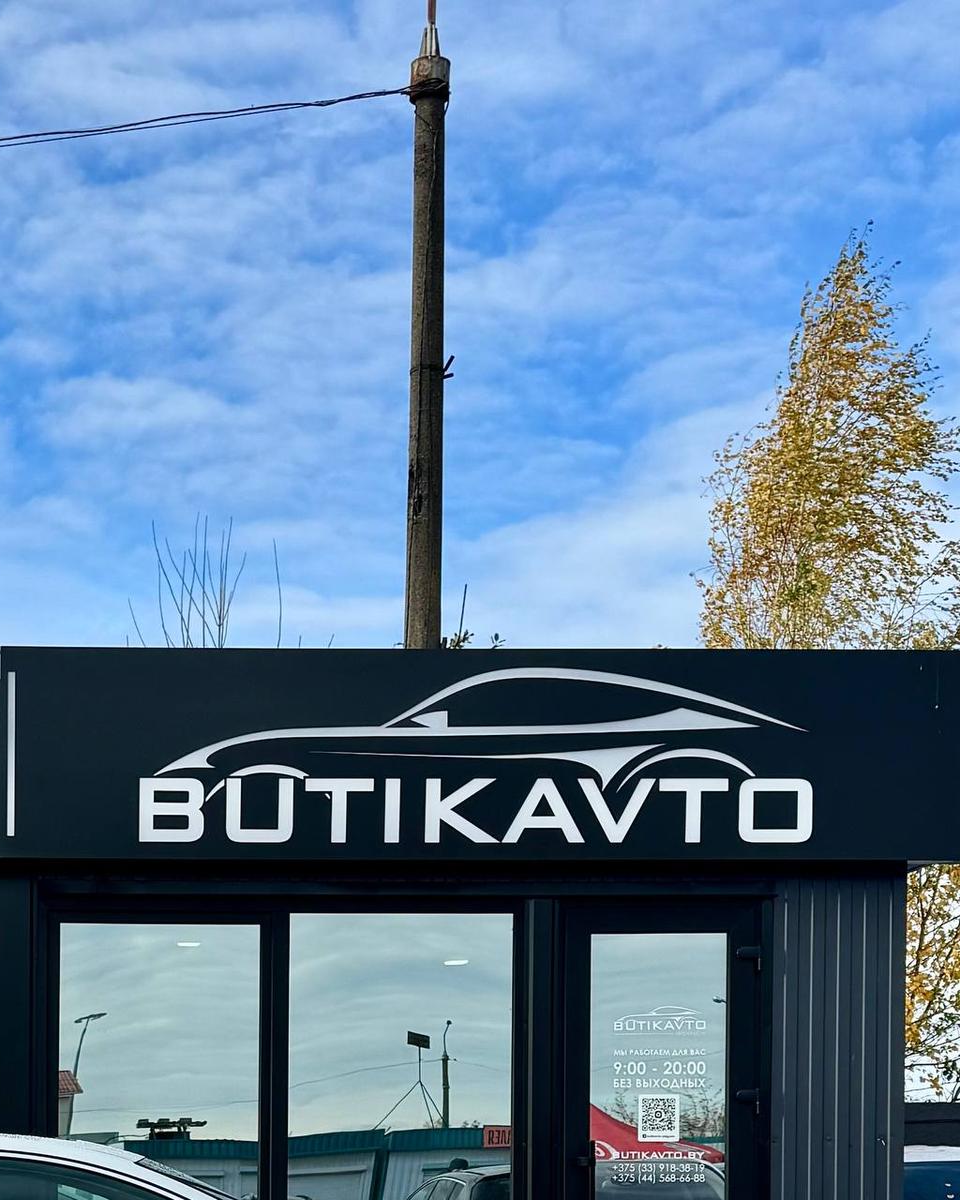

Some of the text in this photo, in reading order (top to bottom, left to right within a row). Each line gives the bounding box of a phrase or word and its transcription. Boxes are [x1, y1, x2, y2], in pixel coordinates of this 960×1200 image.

[138, 776, 813, 844] BUTIKAVTO
[613, 1019, 706, 1031] BUTIKAVTO
[613, 1061, 646, 1075] 9:00
[663, 1061, 706, 1075] 20:00
[613, 1078, 706, 1089] БЕЗ ВЫХОДНЫХ
[612, 1151, 705, 1159] BUTIKAVTO.BY
[612, 1163, 705, 1173] +375 (33) 918-38-19
[612, 1174, 706, 1184] +375 (44) 568-66-88
